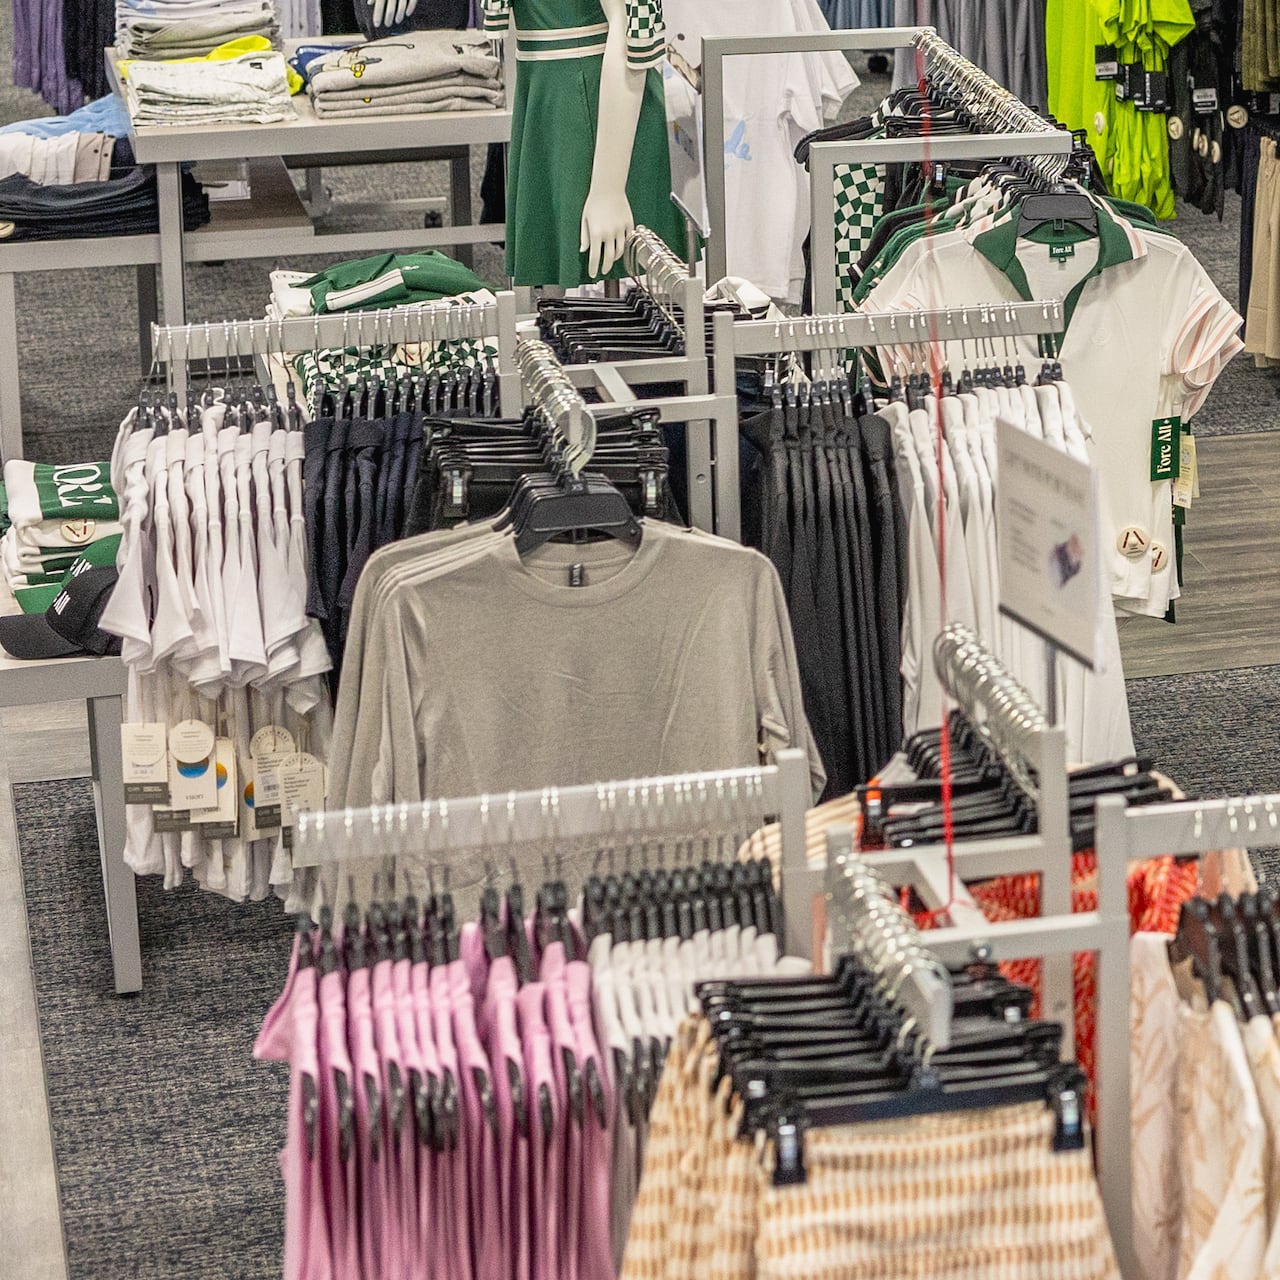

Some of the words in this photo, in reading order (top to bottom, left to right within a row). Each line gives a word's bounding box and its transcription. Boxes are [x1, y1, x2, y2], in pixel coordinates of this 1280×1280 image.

[1157, 423, 1173, 442] All
[1156, 442, 1172, 474] Fore
[53, 464, 113, 508] ORE
